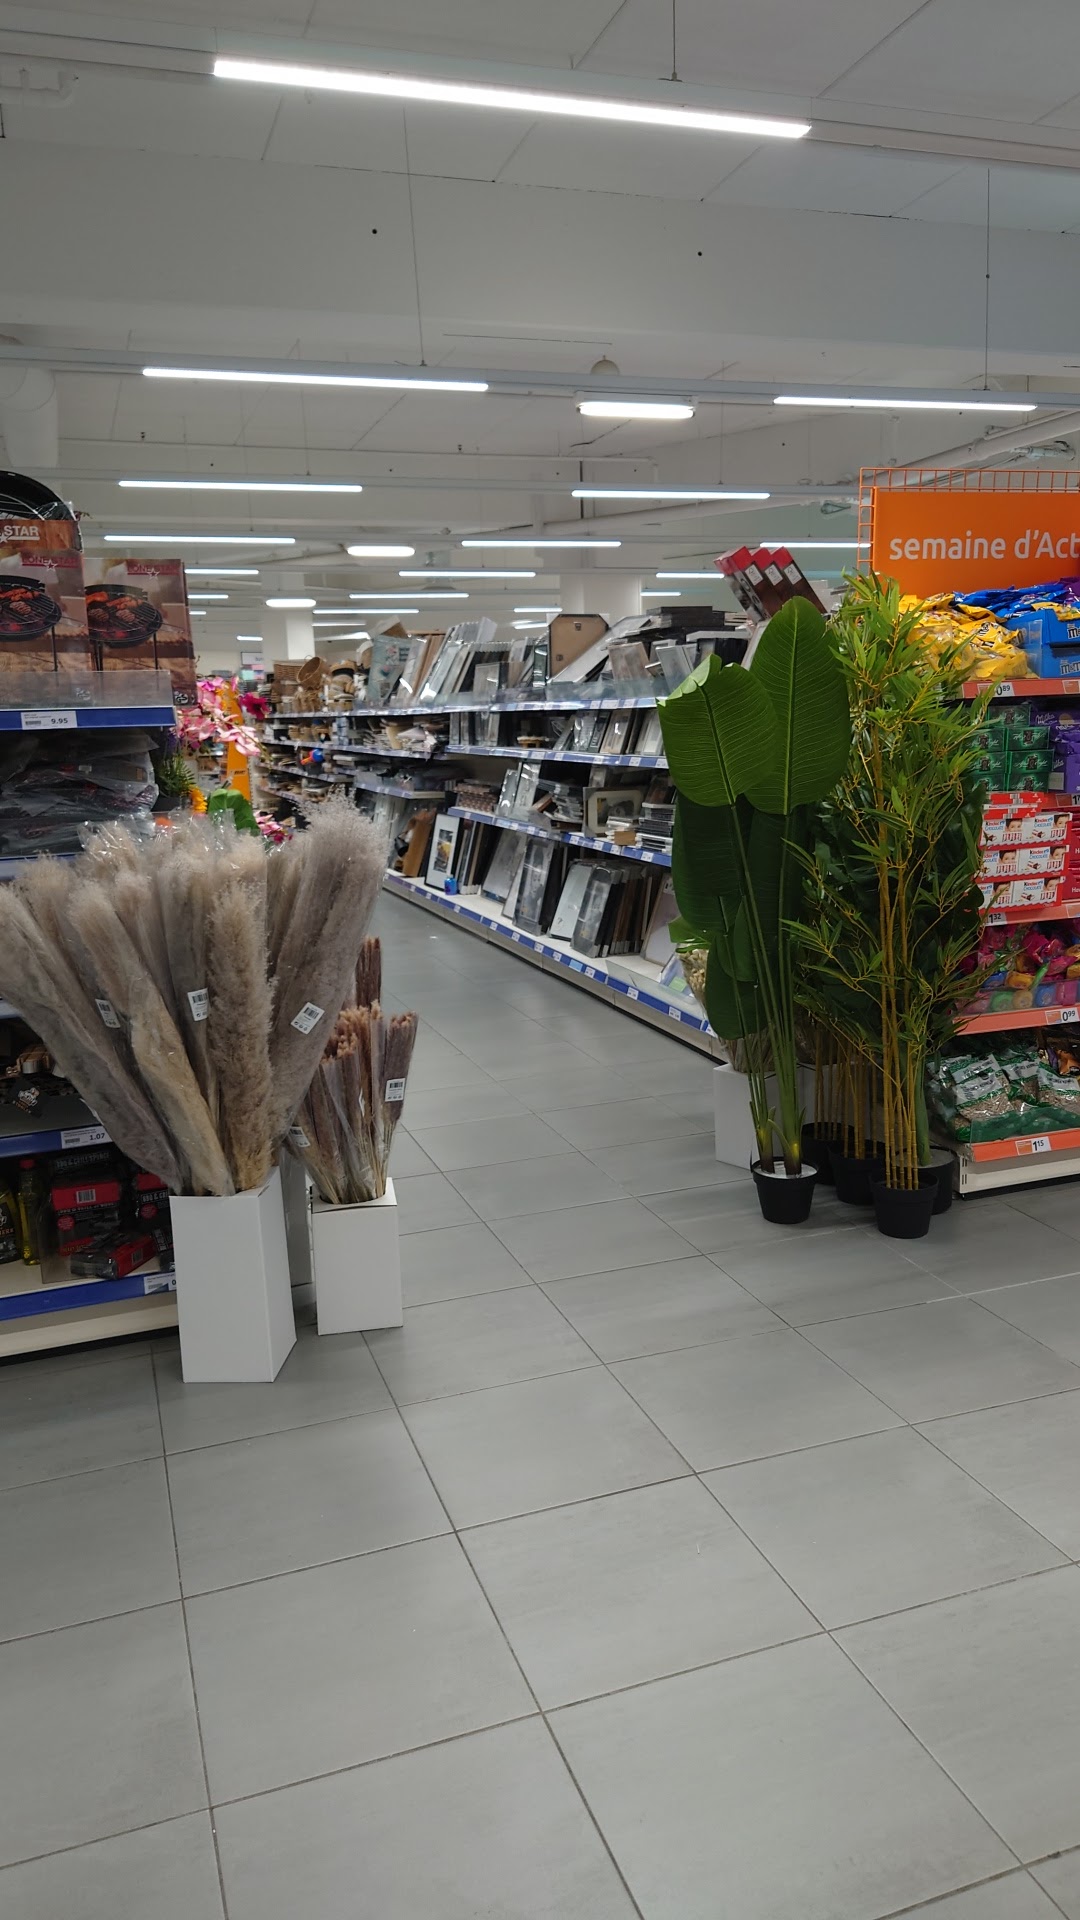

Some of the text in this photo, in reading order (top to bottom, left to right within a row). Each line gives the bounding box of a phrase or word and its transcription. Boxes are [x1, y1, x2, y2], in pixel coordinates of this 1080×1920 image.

[3, 525, 40, 537] STAR
[889, 530, 1006, 560] semaine
[89, 1133, 105, 1141] 1.07
